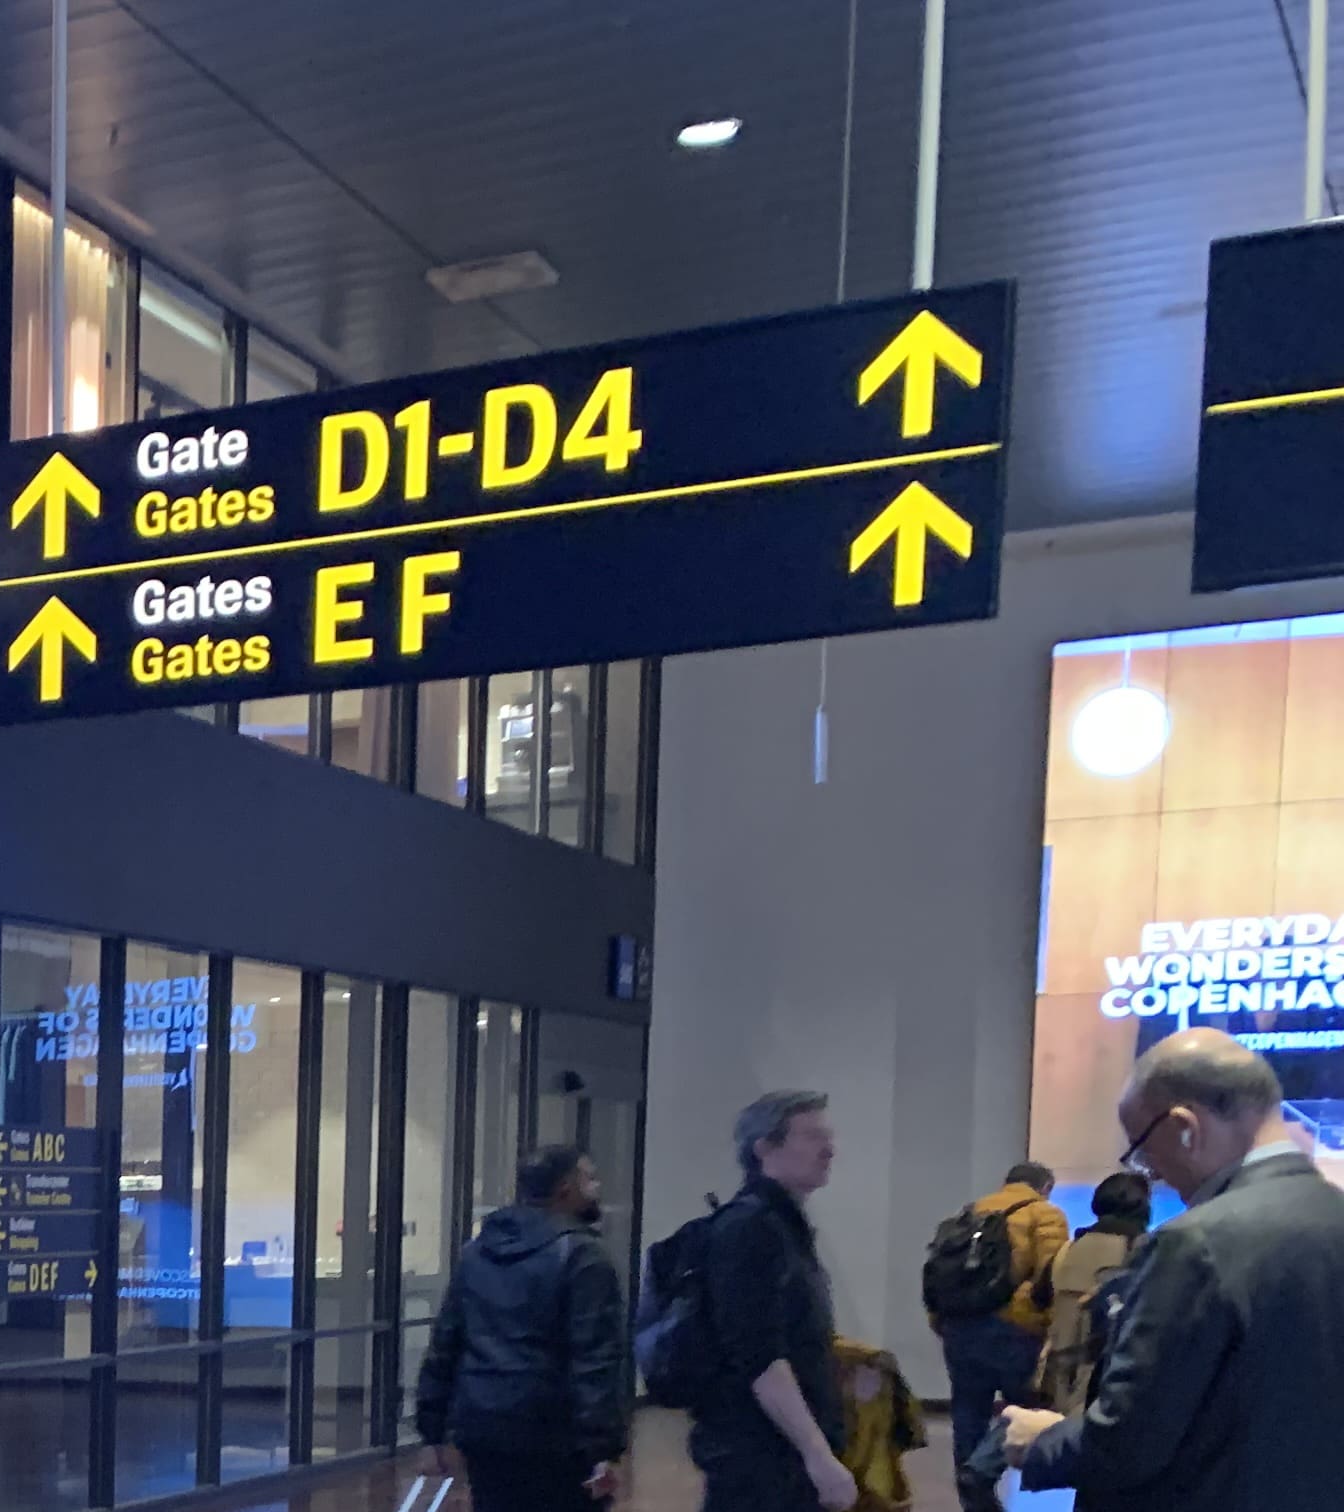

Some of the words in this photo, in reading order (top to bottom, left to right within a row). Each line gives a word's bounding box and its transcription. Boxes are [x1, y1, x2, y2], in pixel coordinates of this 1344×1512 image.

[136, 423, 249, 480] Gate
[318, 366, 643, 514] D1-D4
[134, 483, 275, 539] Gates
[132, 572, 273, 628] Gates
[130, 635, 272, 685] Gates
